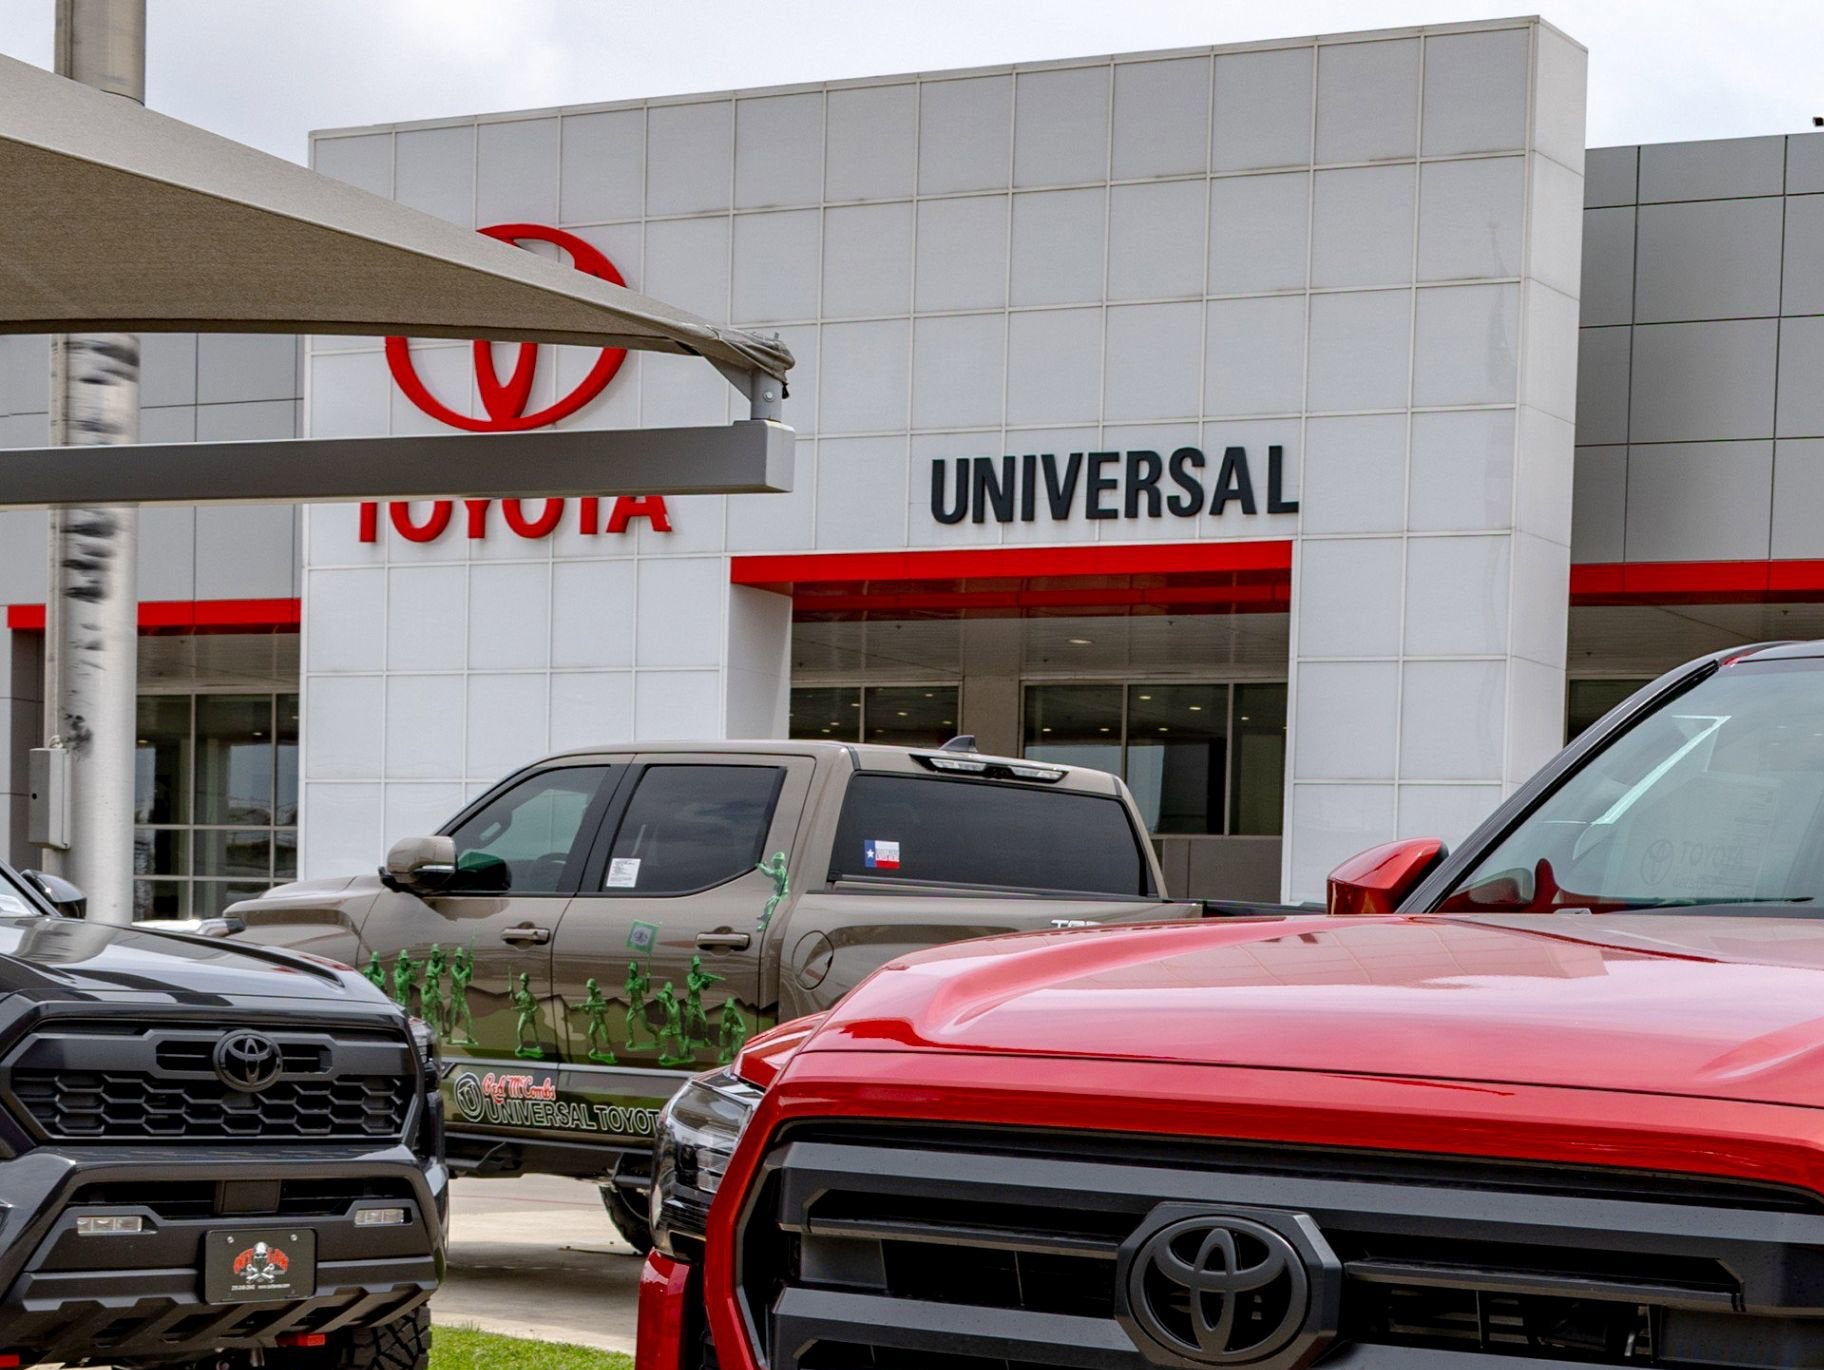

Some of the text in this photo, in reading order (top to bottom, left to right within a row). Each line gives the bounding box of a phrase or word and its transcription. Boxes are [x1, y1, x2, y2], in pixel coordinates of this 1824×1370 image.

[930, 445, 1299, 525] UNIVERSAL
[485, 1098, 660, 1135] UNIVERSAL TOYOT
